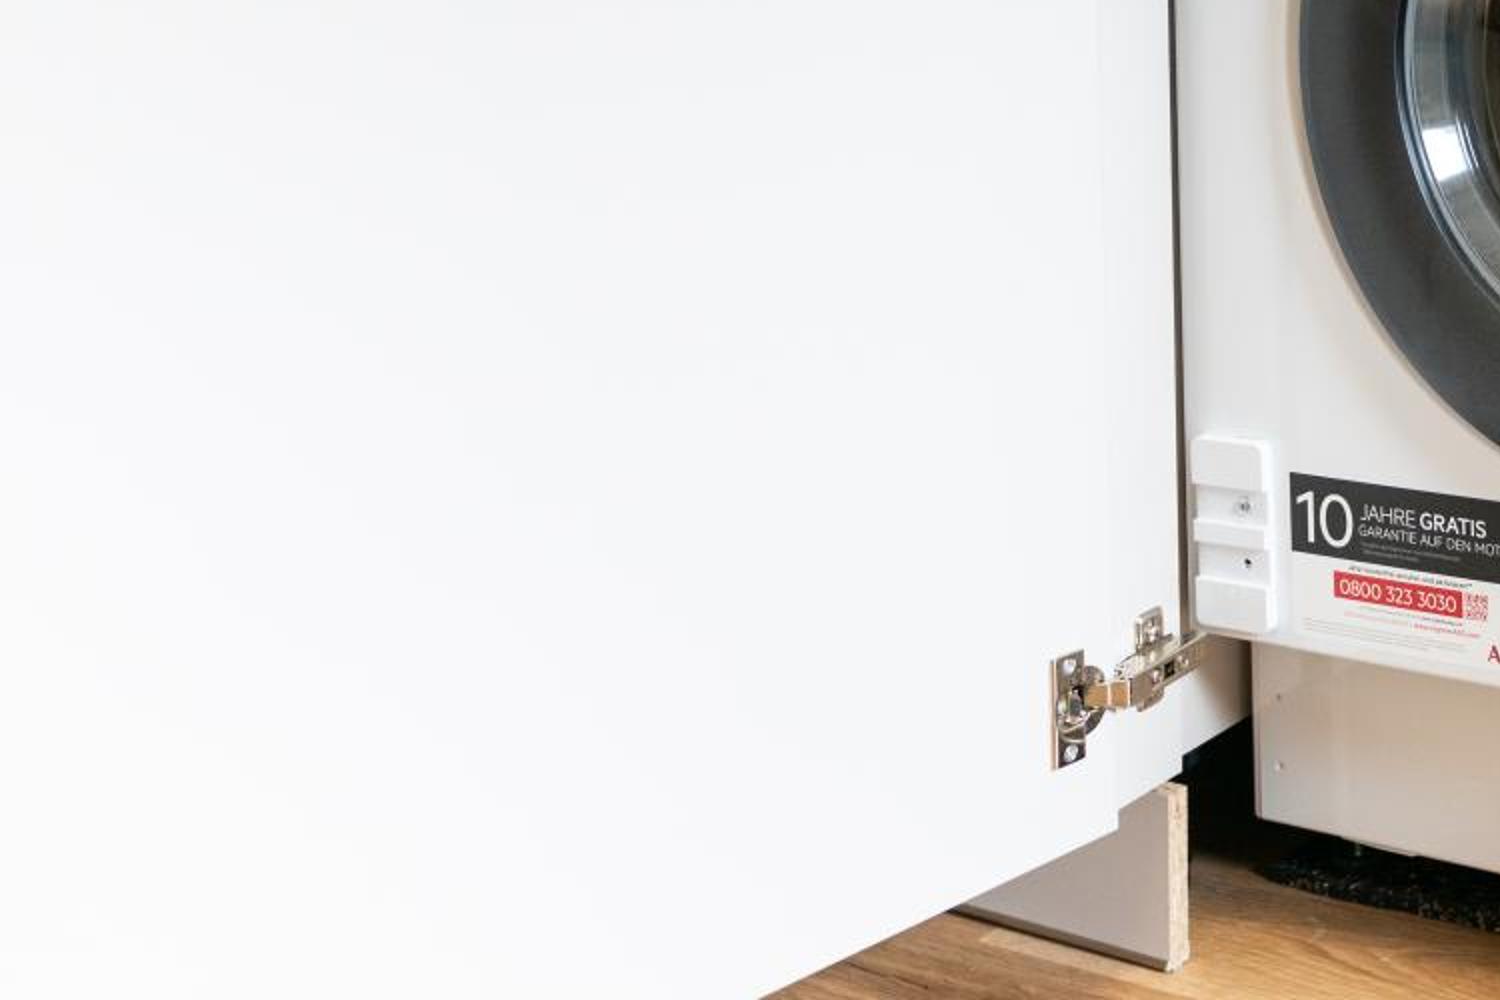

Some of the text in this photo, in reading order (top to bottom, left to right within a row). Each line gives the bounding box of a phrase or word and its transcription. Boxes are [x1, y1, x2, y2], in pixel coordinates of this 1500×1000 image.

[1296, 491, 1487, 549] 10 JAHRE GRATIS
[1358, 524, 1417, 545] GARANTIE
[1420, 530, 1443, 547] AUF
[1446, 537, 1471, 552] DEN
[1339, 578, 1457, 613] 0800 323 3030
